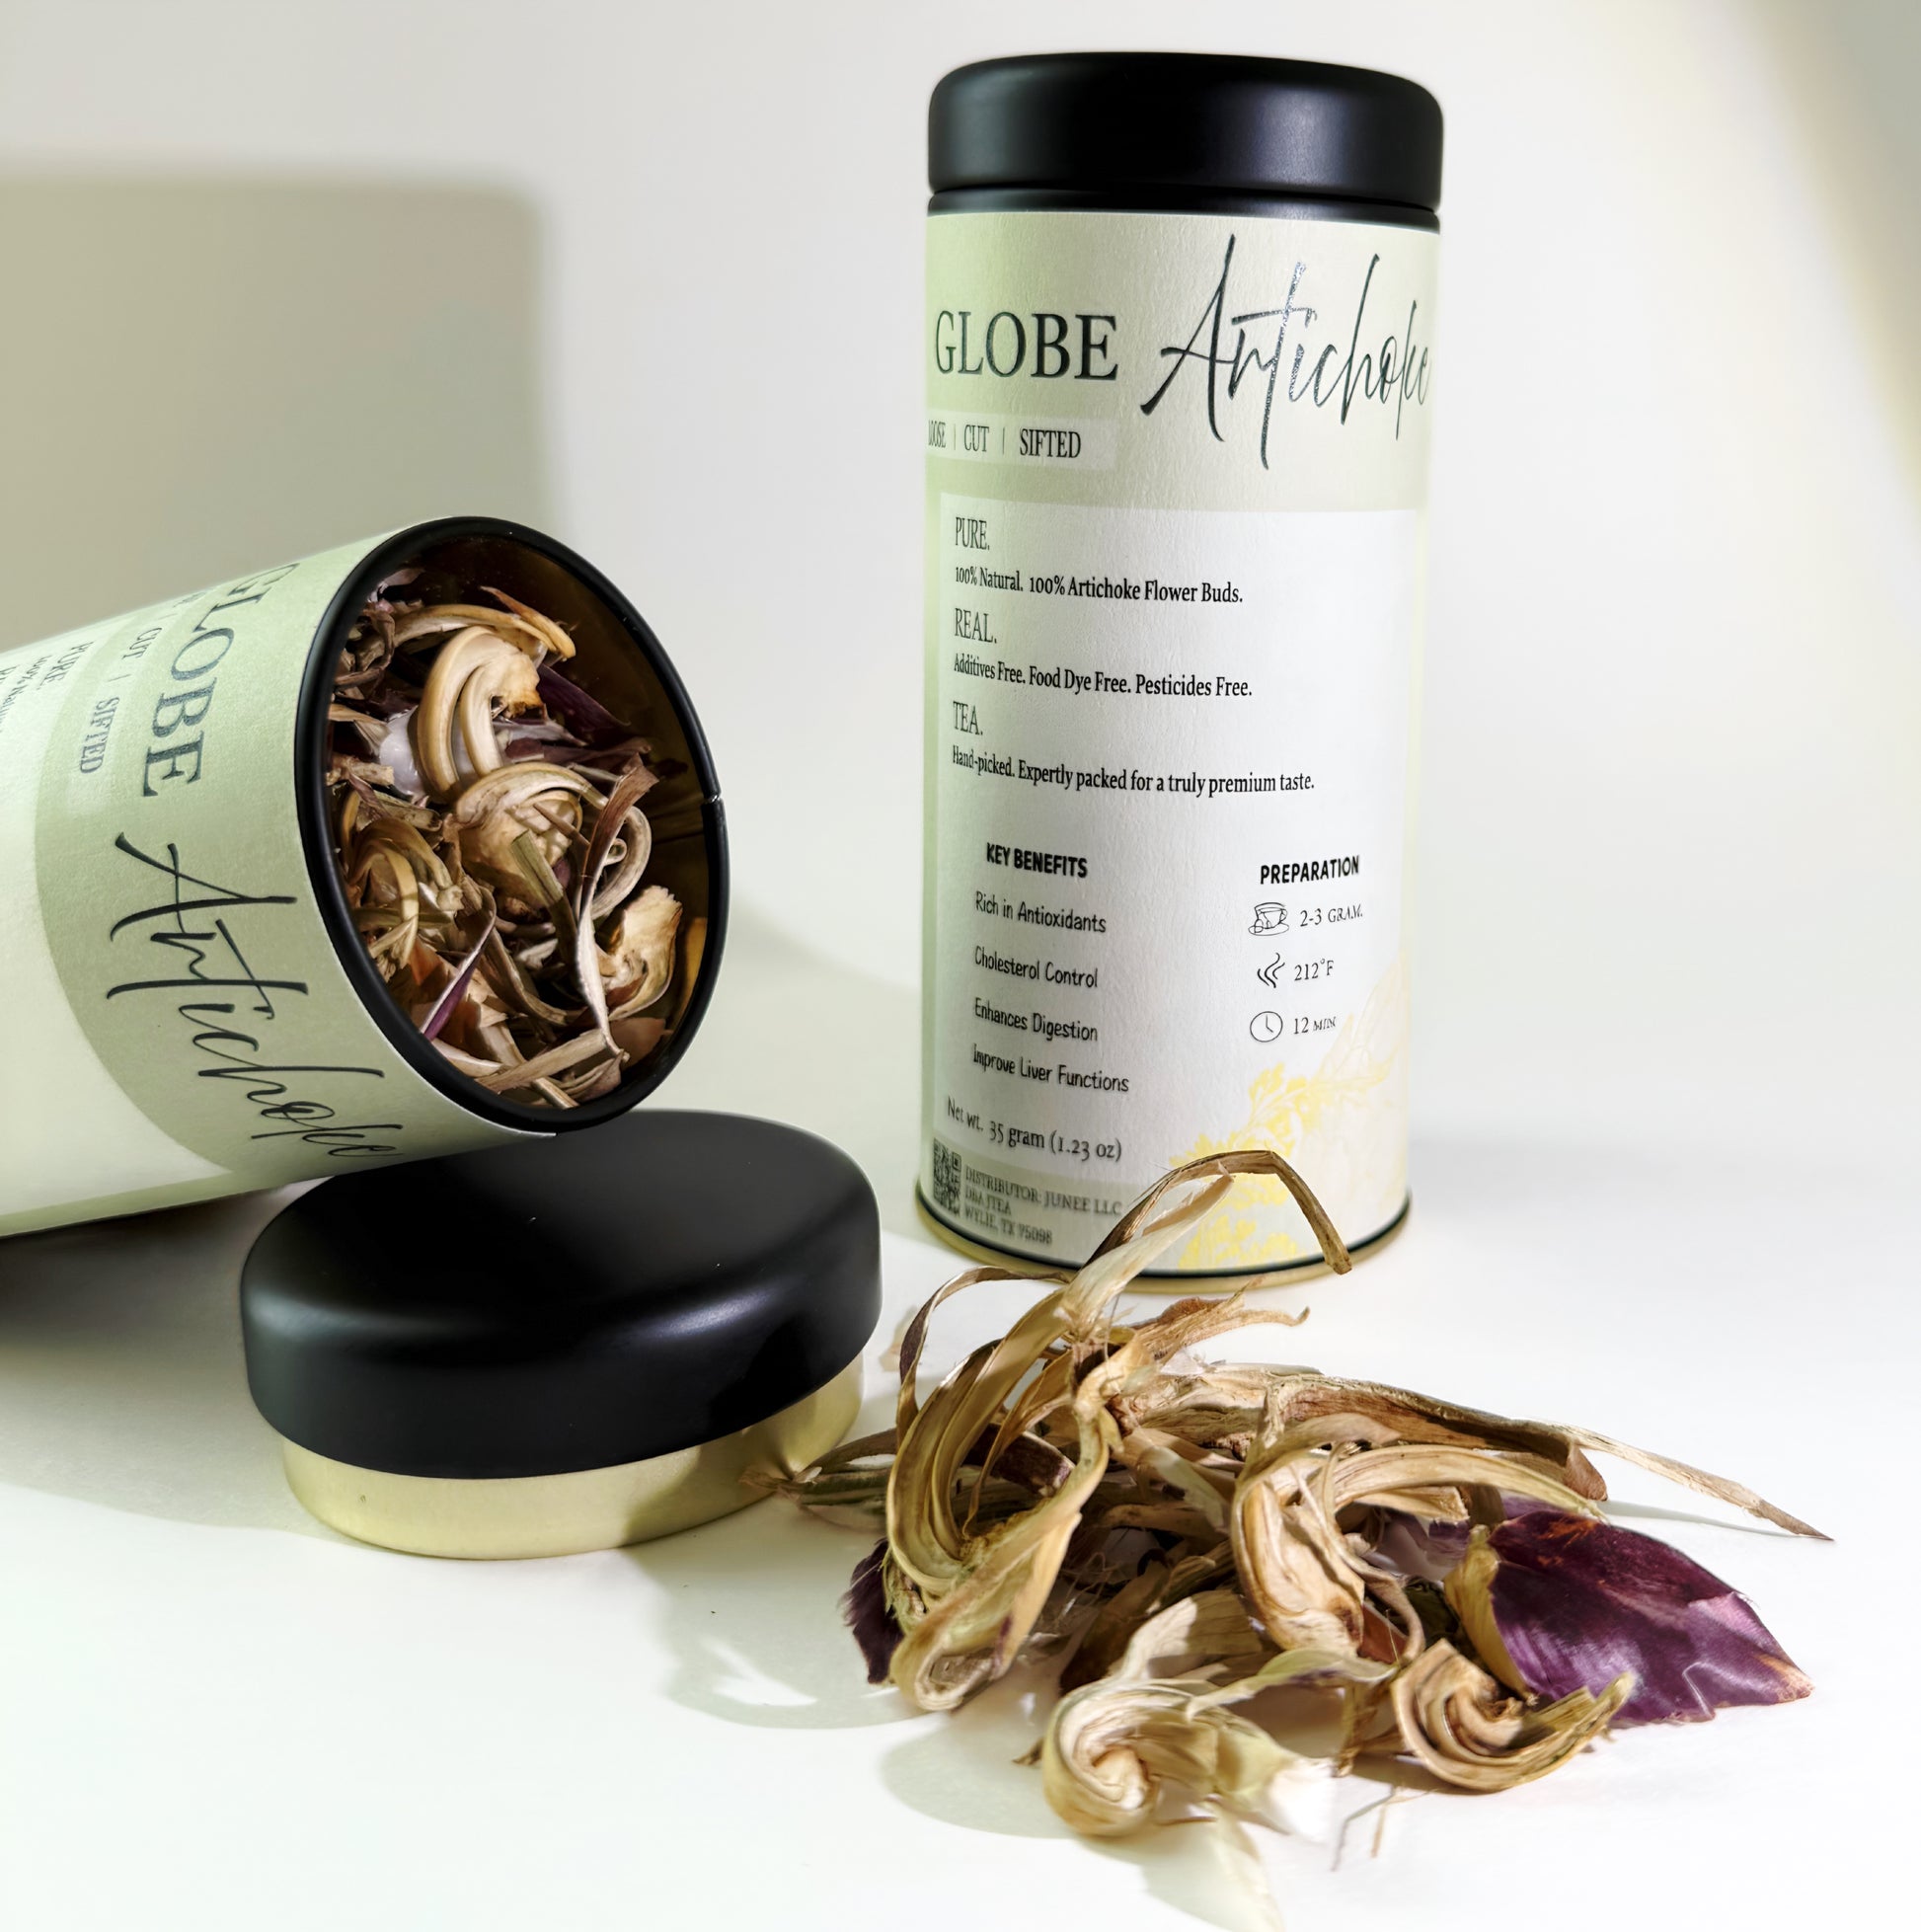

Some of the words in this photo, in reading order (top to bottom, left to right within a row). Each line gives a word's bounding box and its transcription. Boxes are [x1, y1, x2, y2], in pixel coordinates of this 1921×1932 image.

[936, 310, 1118, 381] GLOBE
[1140, 234, 1430, 470] Artichoke
[963, 425, 990, 452] CUT
[1020, 428, 1082, 458] SIFTED
[955, 516, 990, 551] PURE.
[956, 566, 978, 586] 100%
[979, 567, 1024, 592] Natural.
[1030, 575, 1066, 596] 100%
[1067, 576, 1141, 600] Artichoke
[1144, 579, 1198, 602] Flower
[1201, 580, 1244, 603] Buds.
[955, 608, 998, 645] REAL.
[143, 563, 300, 798] GLOBE
[954, 653, 996, 680] Additives
[997, 660, 1027, 684] Free.
[1029, 665, 1061, 689] Food
[1064, 668, 1092, 695] Dye
[1095, 671, 1132, 694] Free.
[1135, 673, 1212, 697] Pesticides
[1215, 676, 1253, 697] Free.
[79, 696, 120, 774] SIFTED
[953, 700, 984, 736] TEA.
[953, 744, 1016, 777] Hand-picked.
[1018, 759, 1074, 791] Expertly
[1076, 767, 1127, 792] packed
[1130, 769, 1154, 792] for
[1156, 777, 1165, 792] a
[1169, 771, 1206, 799] truly
[1208, 771, 1276, 799] premium
[1280, 772, 1315, 792] taste.
[986, 842, 1011, 867] KEY
[1014, 848, 1088, 879] BENEFITS
[1260, 855, 1360, 886] PREPARATION
[975, 890, 999, 916] Rich
[1003, 898, 1014, 919] in
[1018, 900, 1107, 933] Antioxidants
[1299, 908, 1323, 927] 2-3
[974, 945, 1040, 980] Cholesterol
[1045, 962, 1099, 988] Control
[107, 832, 404, 1158] Artichoke
[974, 997, 1029, 1031] Enhances
[1033, 1012, 1099, 1042] Digestion
[1294, 1017, 1309, 1035] 12
[972, 1043, 1016, 1075] Improve
[1020, 1056, 1053, 1082] Liver
[1057, 1064, 1129, 1092] Functions
[948, 1096, 964, 1122] Net
[966, 1115, 984, 1132] wt.
[990, 1121, 1004, 1144] 35
[1008, 1126, 1045, 1148] gram
[1049, 1129, 1090, 1161] (1.23
[1096, 1137, 1122, 1163] oz)
[1043, 1192, 1090, 1212] JUNEE
[1093, 1198, 1123, 1216] LLC
